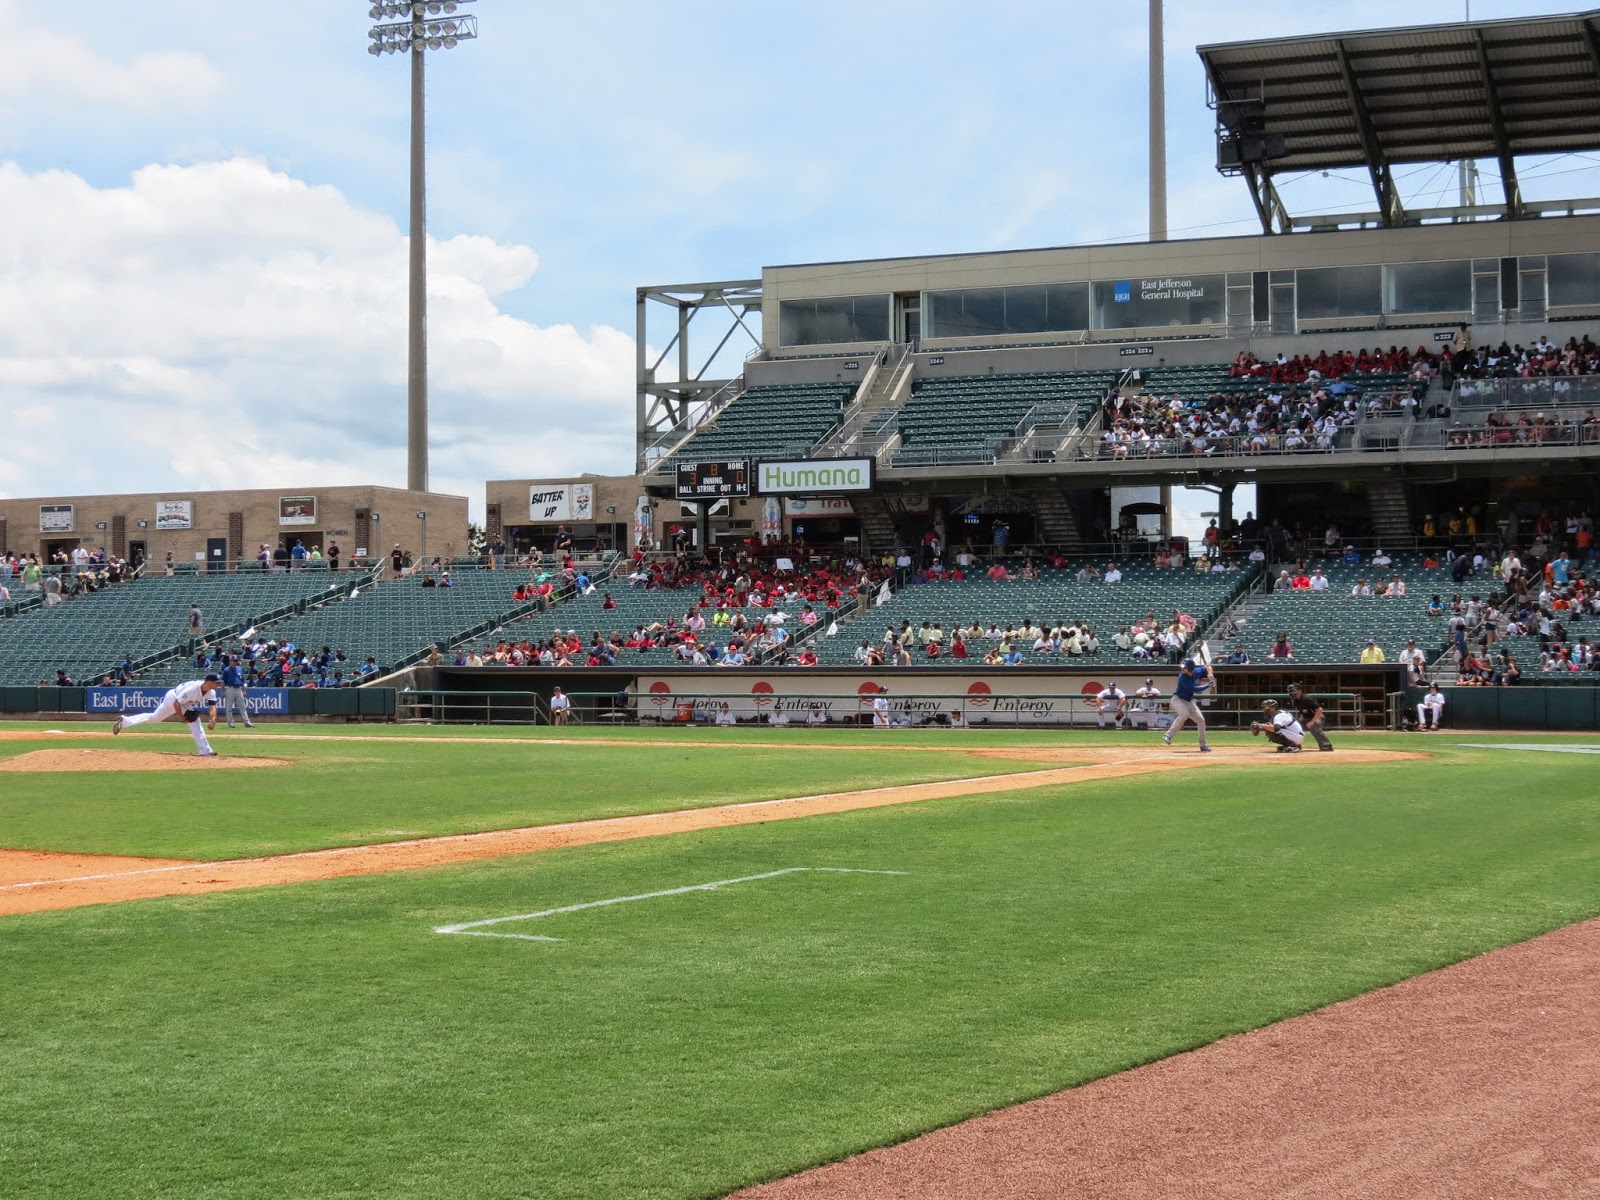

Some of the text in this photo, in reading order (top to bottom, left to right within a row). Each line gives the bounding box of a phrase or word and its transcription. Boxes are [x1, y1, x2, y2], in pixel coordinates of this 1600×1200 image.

[1141, 279, 1192, 290] East Jefferson
[1141, 288, 1204, 300] General Hospital
[680, 464, 698, 472] GUEST
[727, 462, 745, 470] HOME
[702, 477, 723, 485] INNING
[765, 466, 860, 488] Humana
[679, 486, 693, 494] BALL
[696, 485, 716, 493] STRIKE
[720, 484, 732, 492] OUT
[531, 490, 564, 505] BATTER
[544, 506, 558, 518] UP
[92, 692, 118, 708] East
[120, 690, 166, 711] Jeffers
[993, 697, 1054, 718] Entergy
